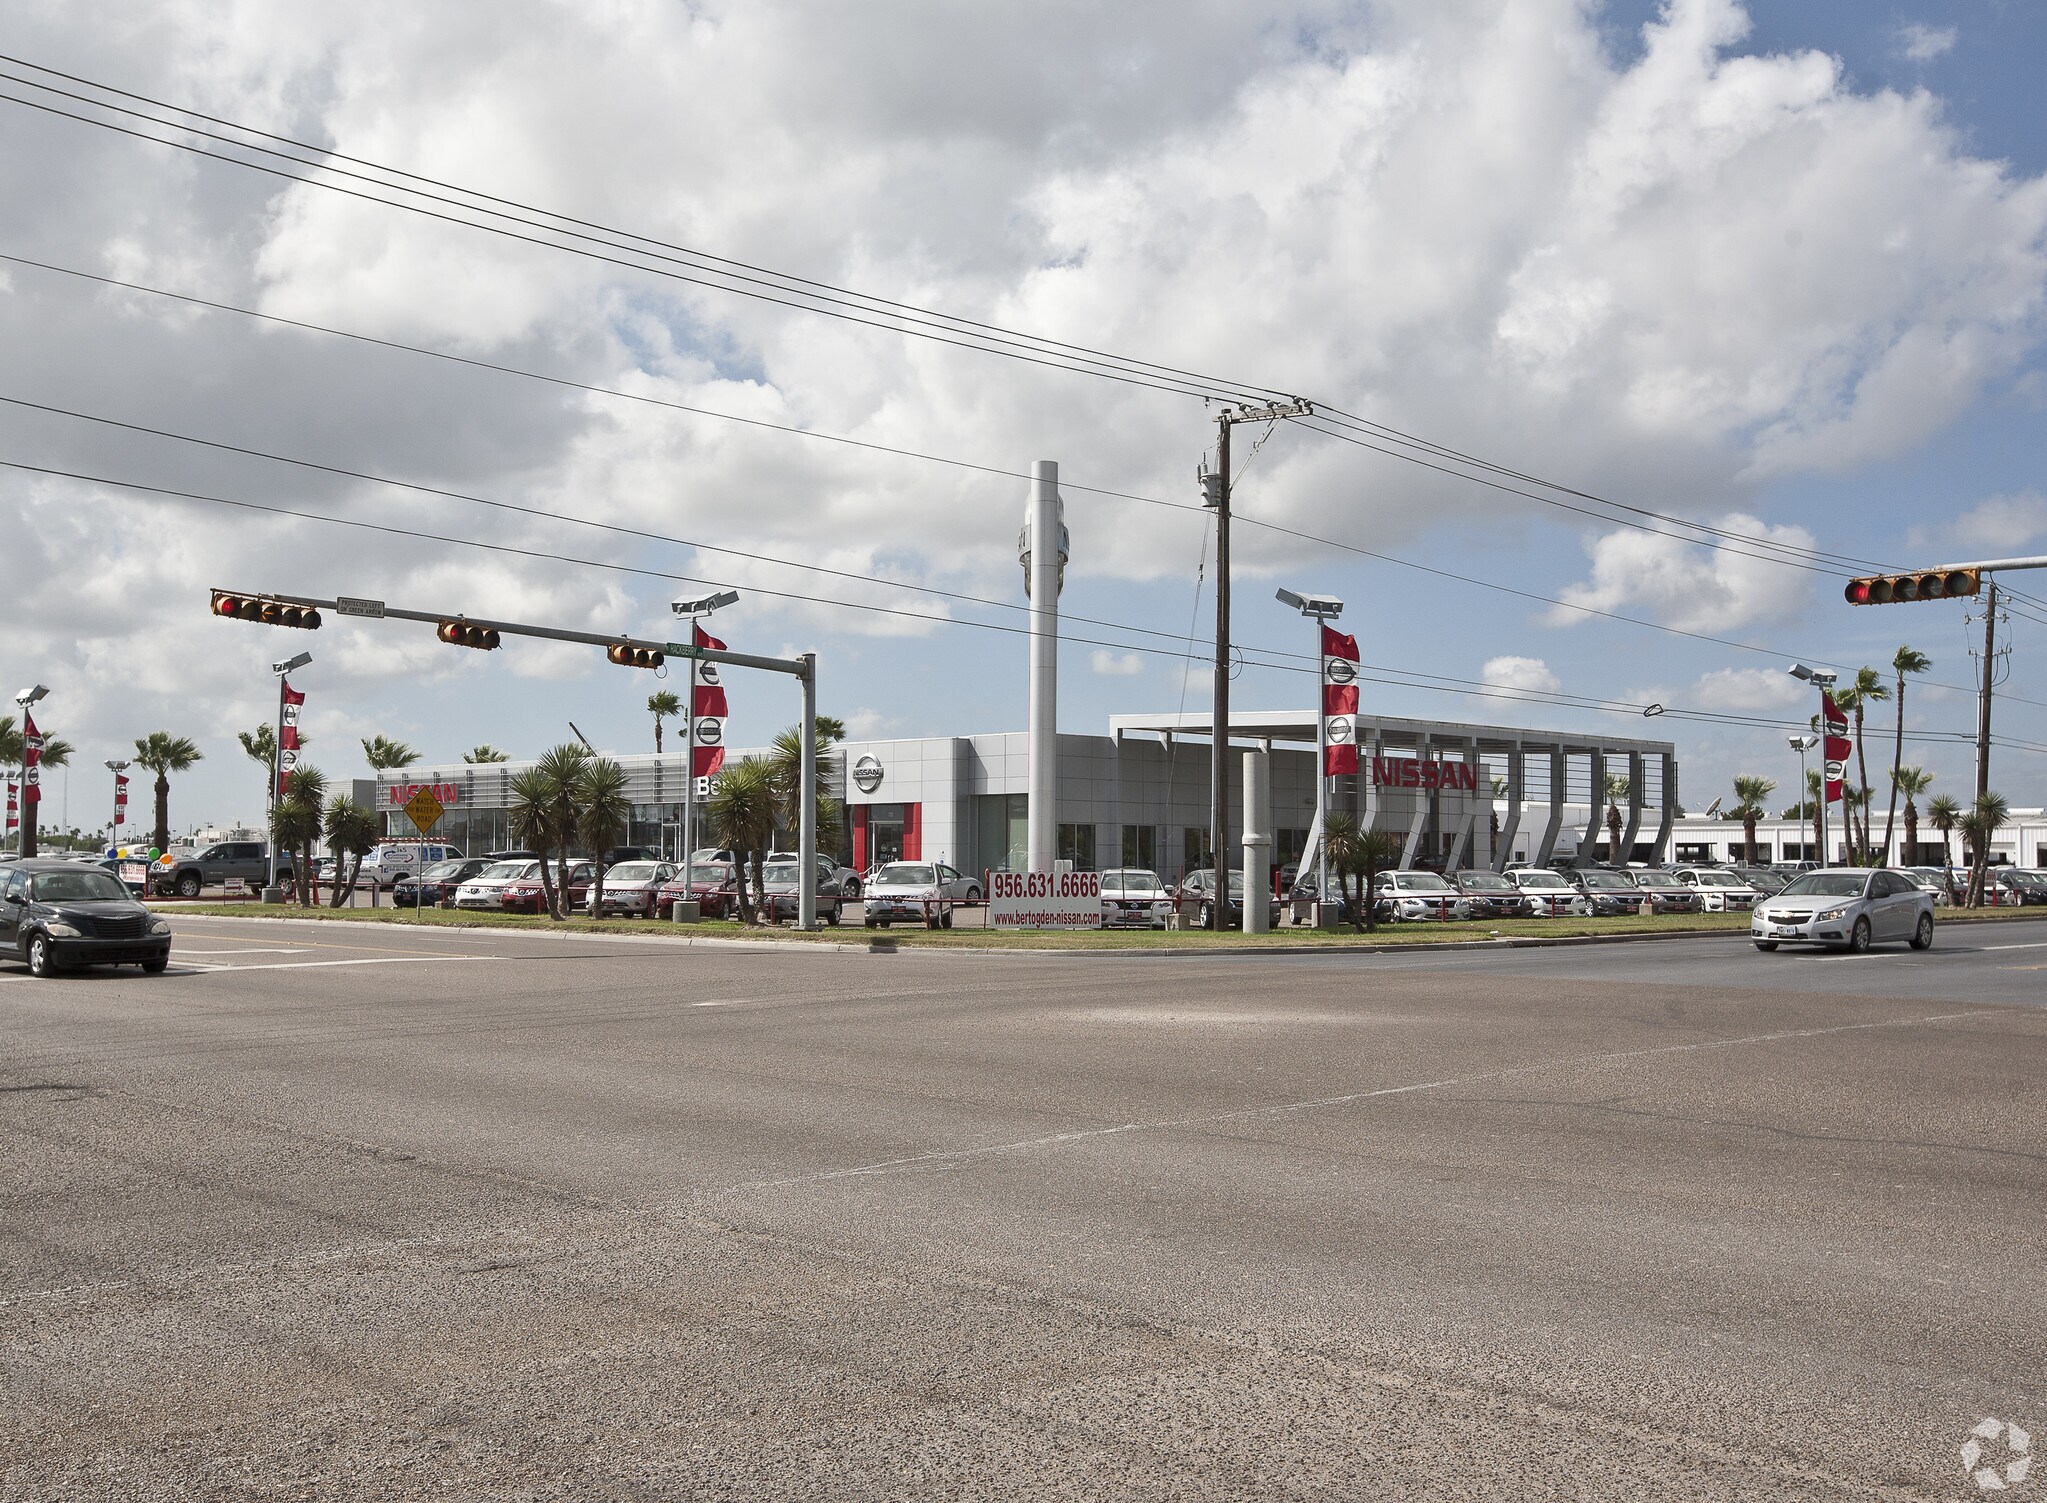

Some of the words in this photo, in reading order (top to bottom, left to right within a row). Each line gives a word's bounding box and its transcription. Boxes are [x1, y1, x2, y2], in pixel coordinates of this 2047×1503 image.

[341, 600, 368, 608] PROTECTED
[365, 608, 381, 616] ARROW
[670, 644, 697, 656] HACKBERRY
[853, 768, 880, 777] NISSAN
[1372, 757, 1477, 790] NISSAN
[389, 783, 457, 804] NISAN
[415, 798, 434, 806] WATCH
[415, 806, 433, 814] WATER
[416, 815, 432, 823] ROAD
[994, 873, 1098, 898] 956.631.6666
[994, 909, 1100, 928] www.bertogden-nissan.com
